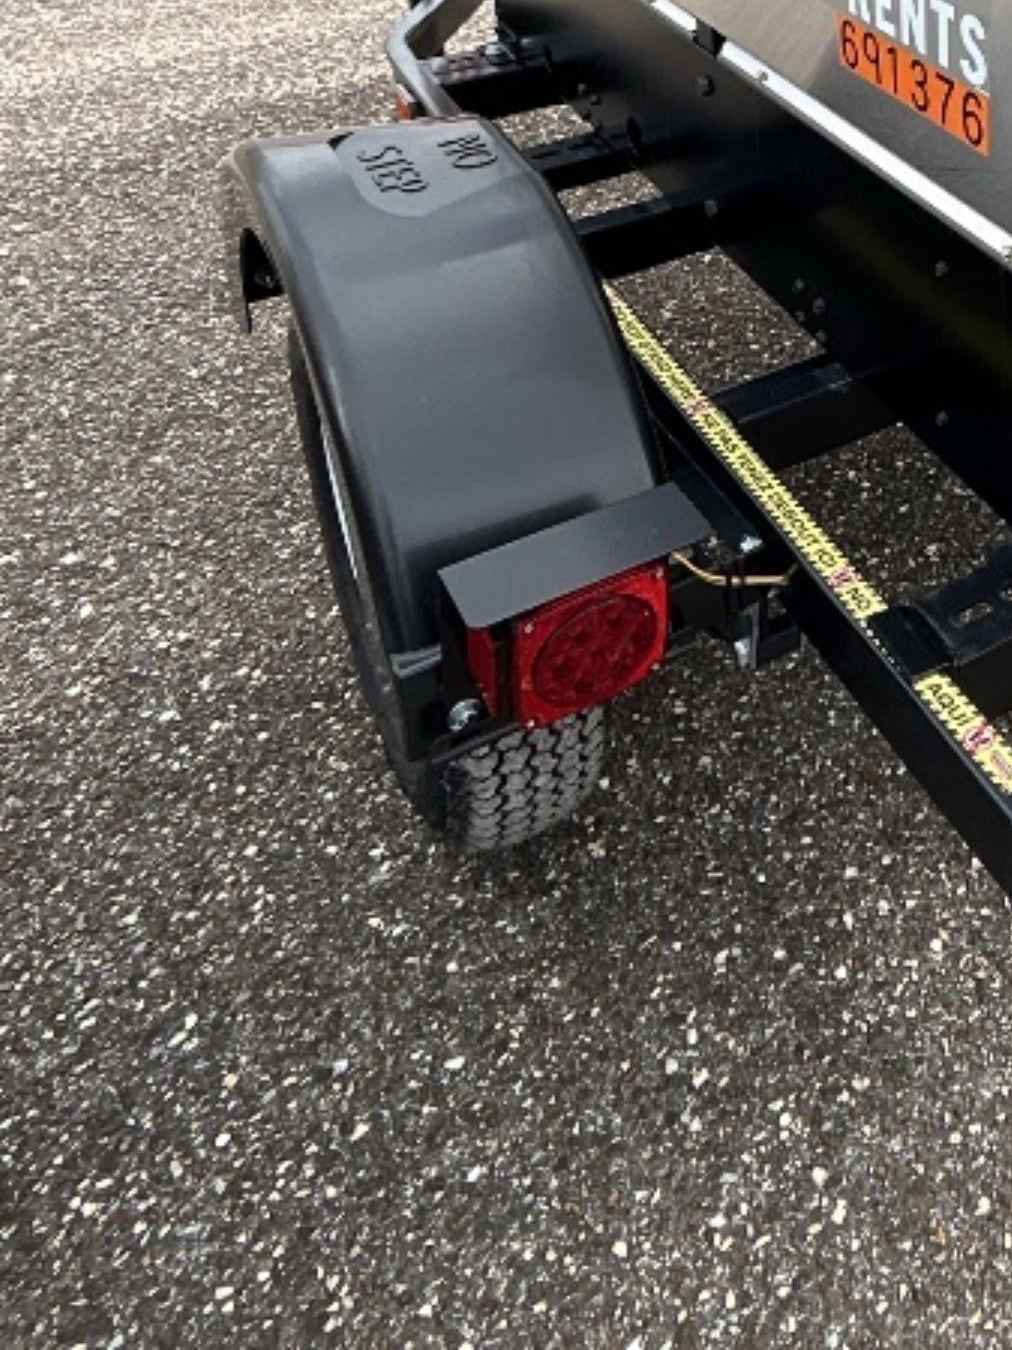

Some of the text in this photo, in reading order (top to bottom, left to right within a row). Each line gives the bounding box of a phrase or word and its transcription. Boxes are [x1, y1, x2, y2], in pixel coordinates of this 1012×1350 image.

[840, 20, 984, 148] 691376
[356, 145, 430, 193] STEP
[437, 133, 498, 169] NO
[846, 583, 873, 613] NO
[926, 679, 972, 730] AQUI
